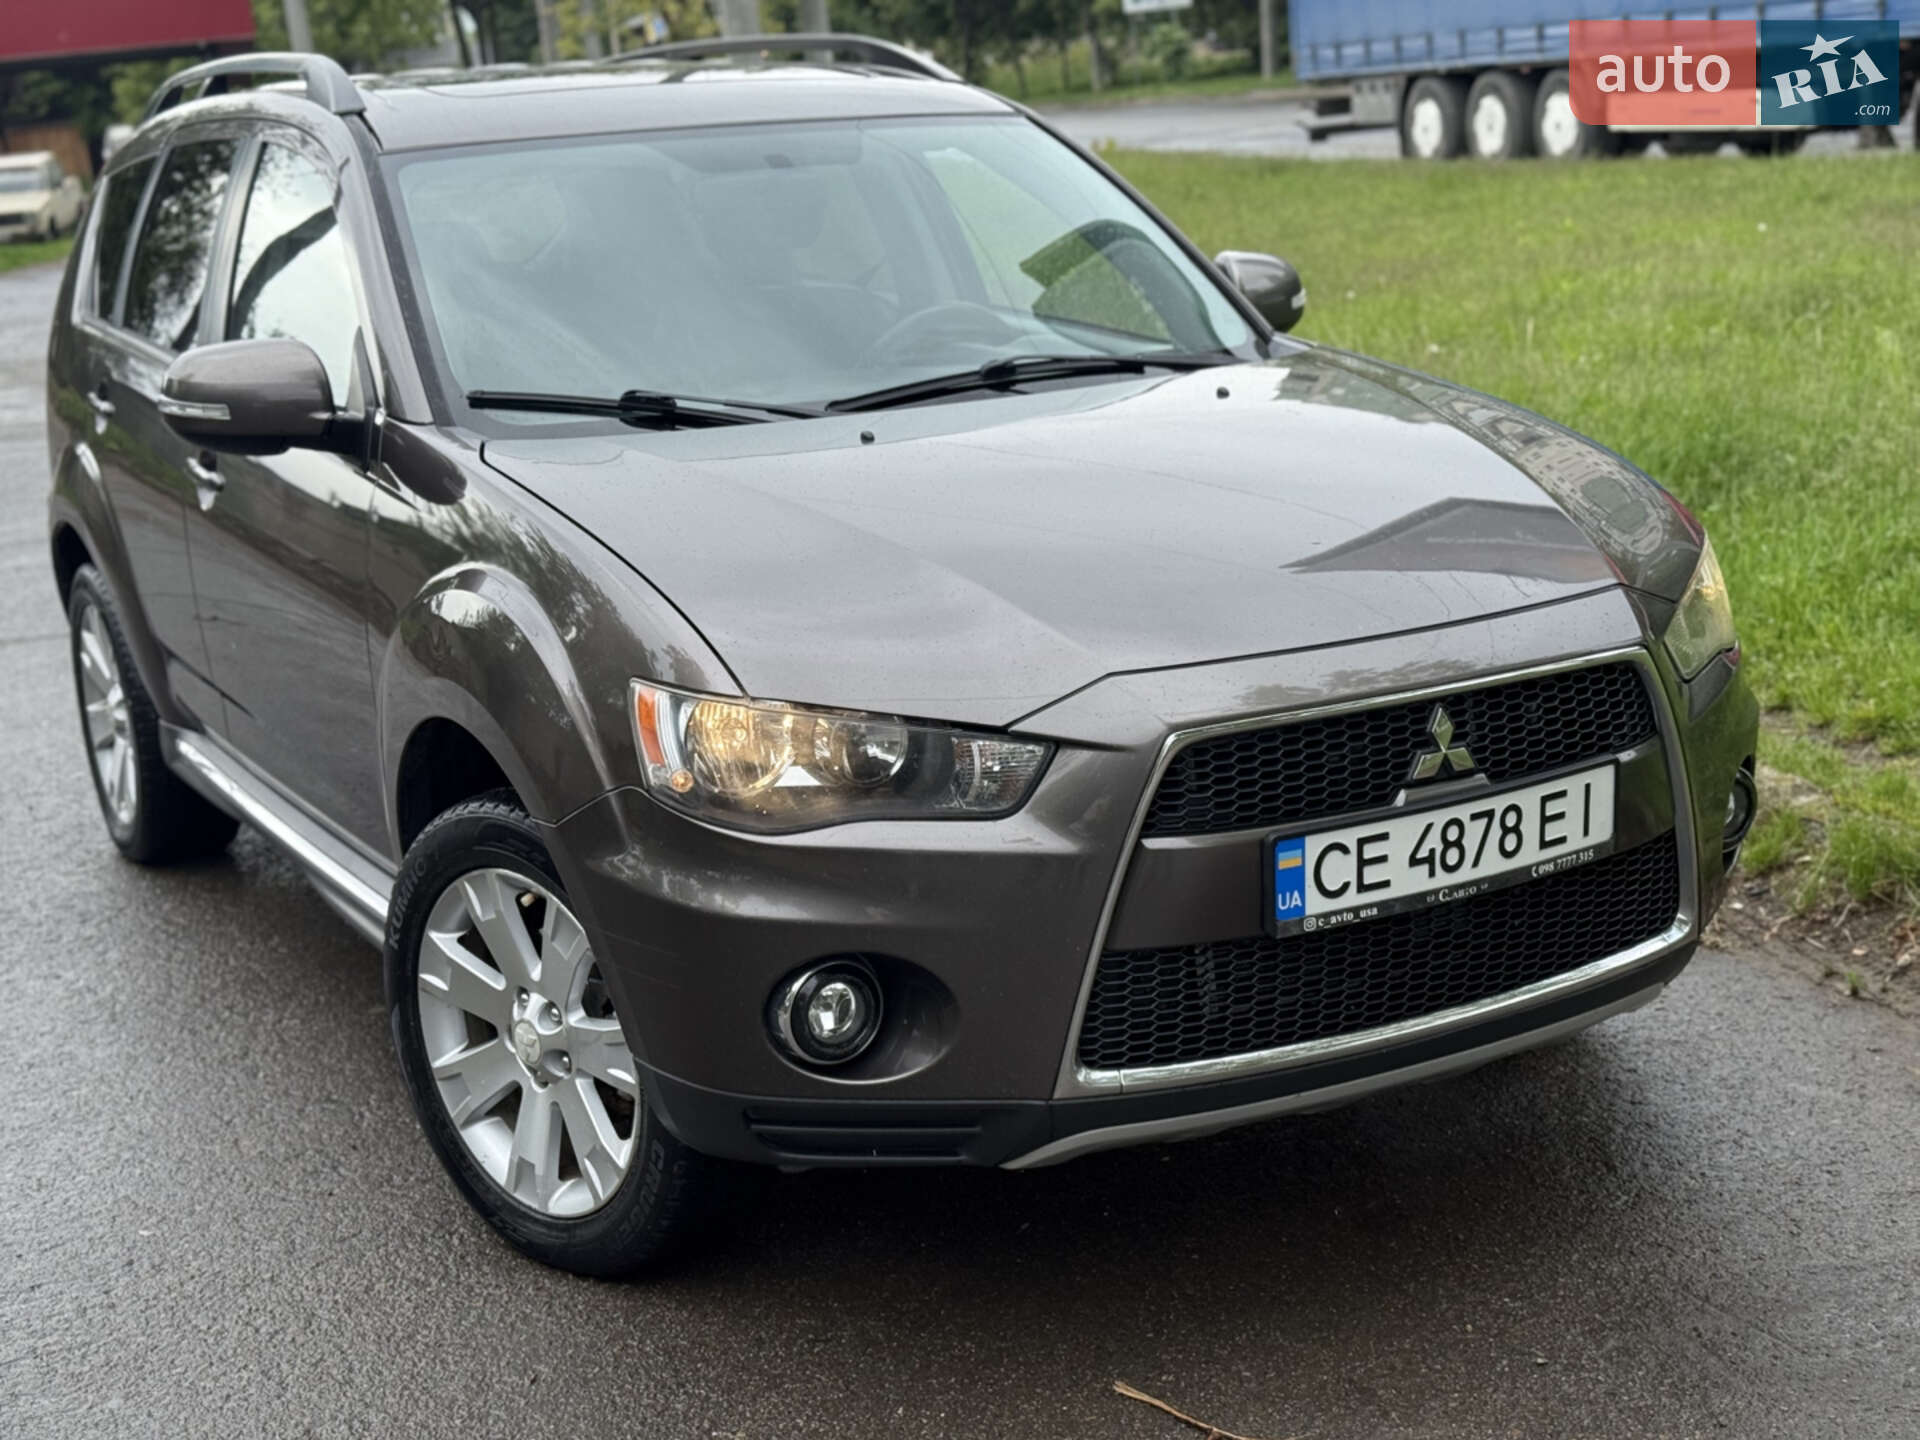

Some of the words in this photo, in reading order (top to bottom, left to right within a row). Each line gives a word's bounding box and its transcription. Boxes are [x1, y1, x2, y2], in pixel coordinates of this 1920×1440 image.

[1313, 831, 1391, 899] CE
[1408, 803, 1523, 879] 4878
[1540, 782, 1591, 850] EI
[1278, 890, 1302, 911] UA
